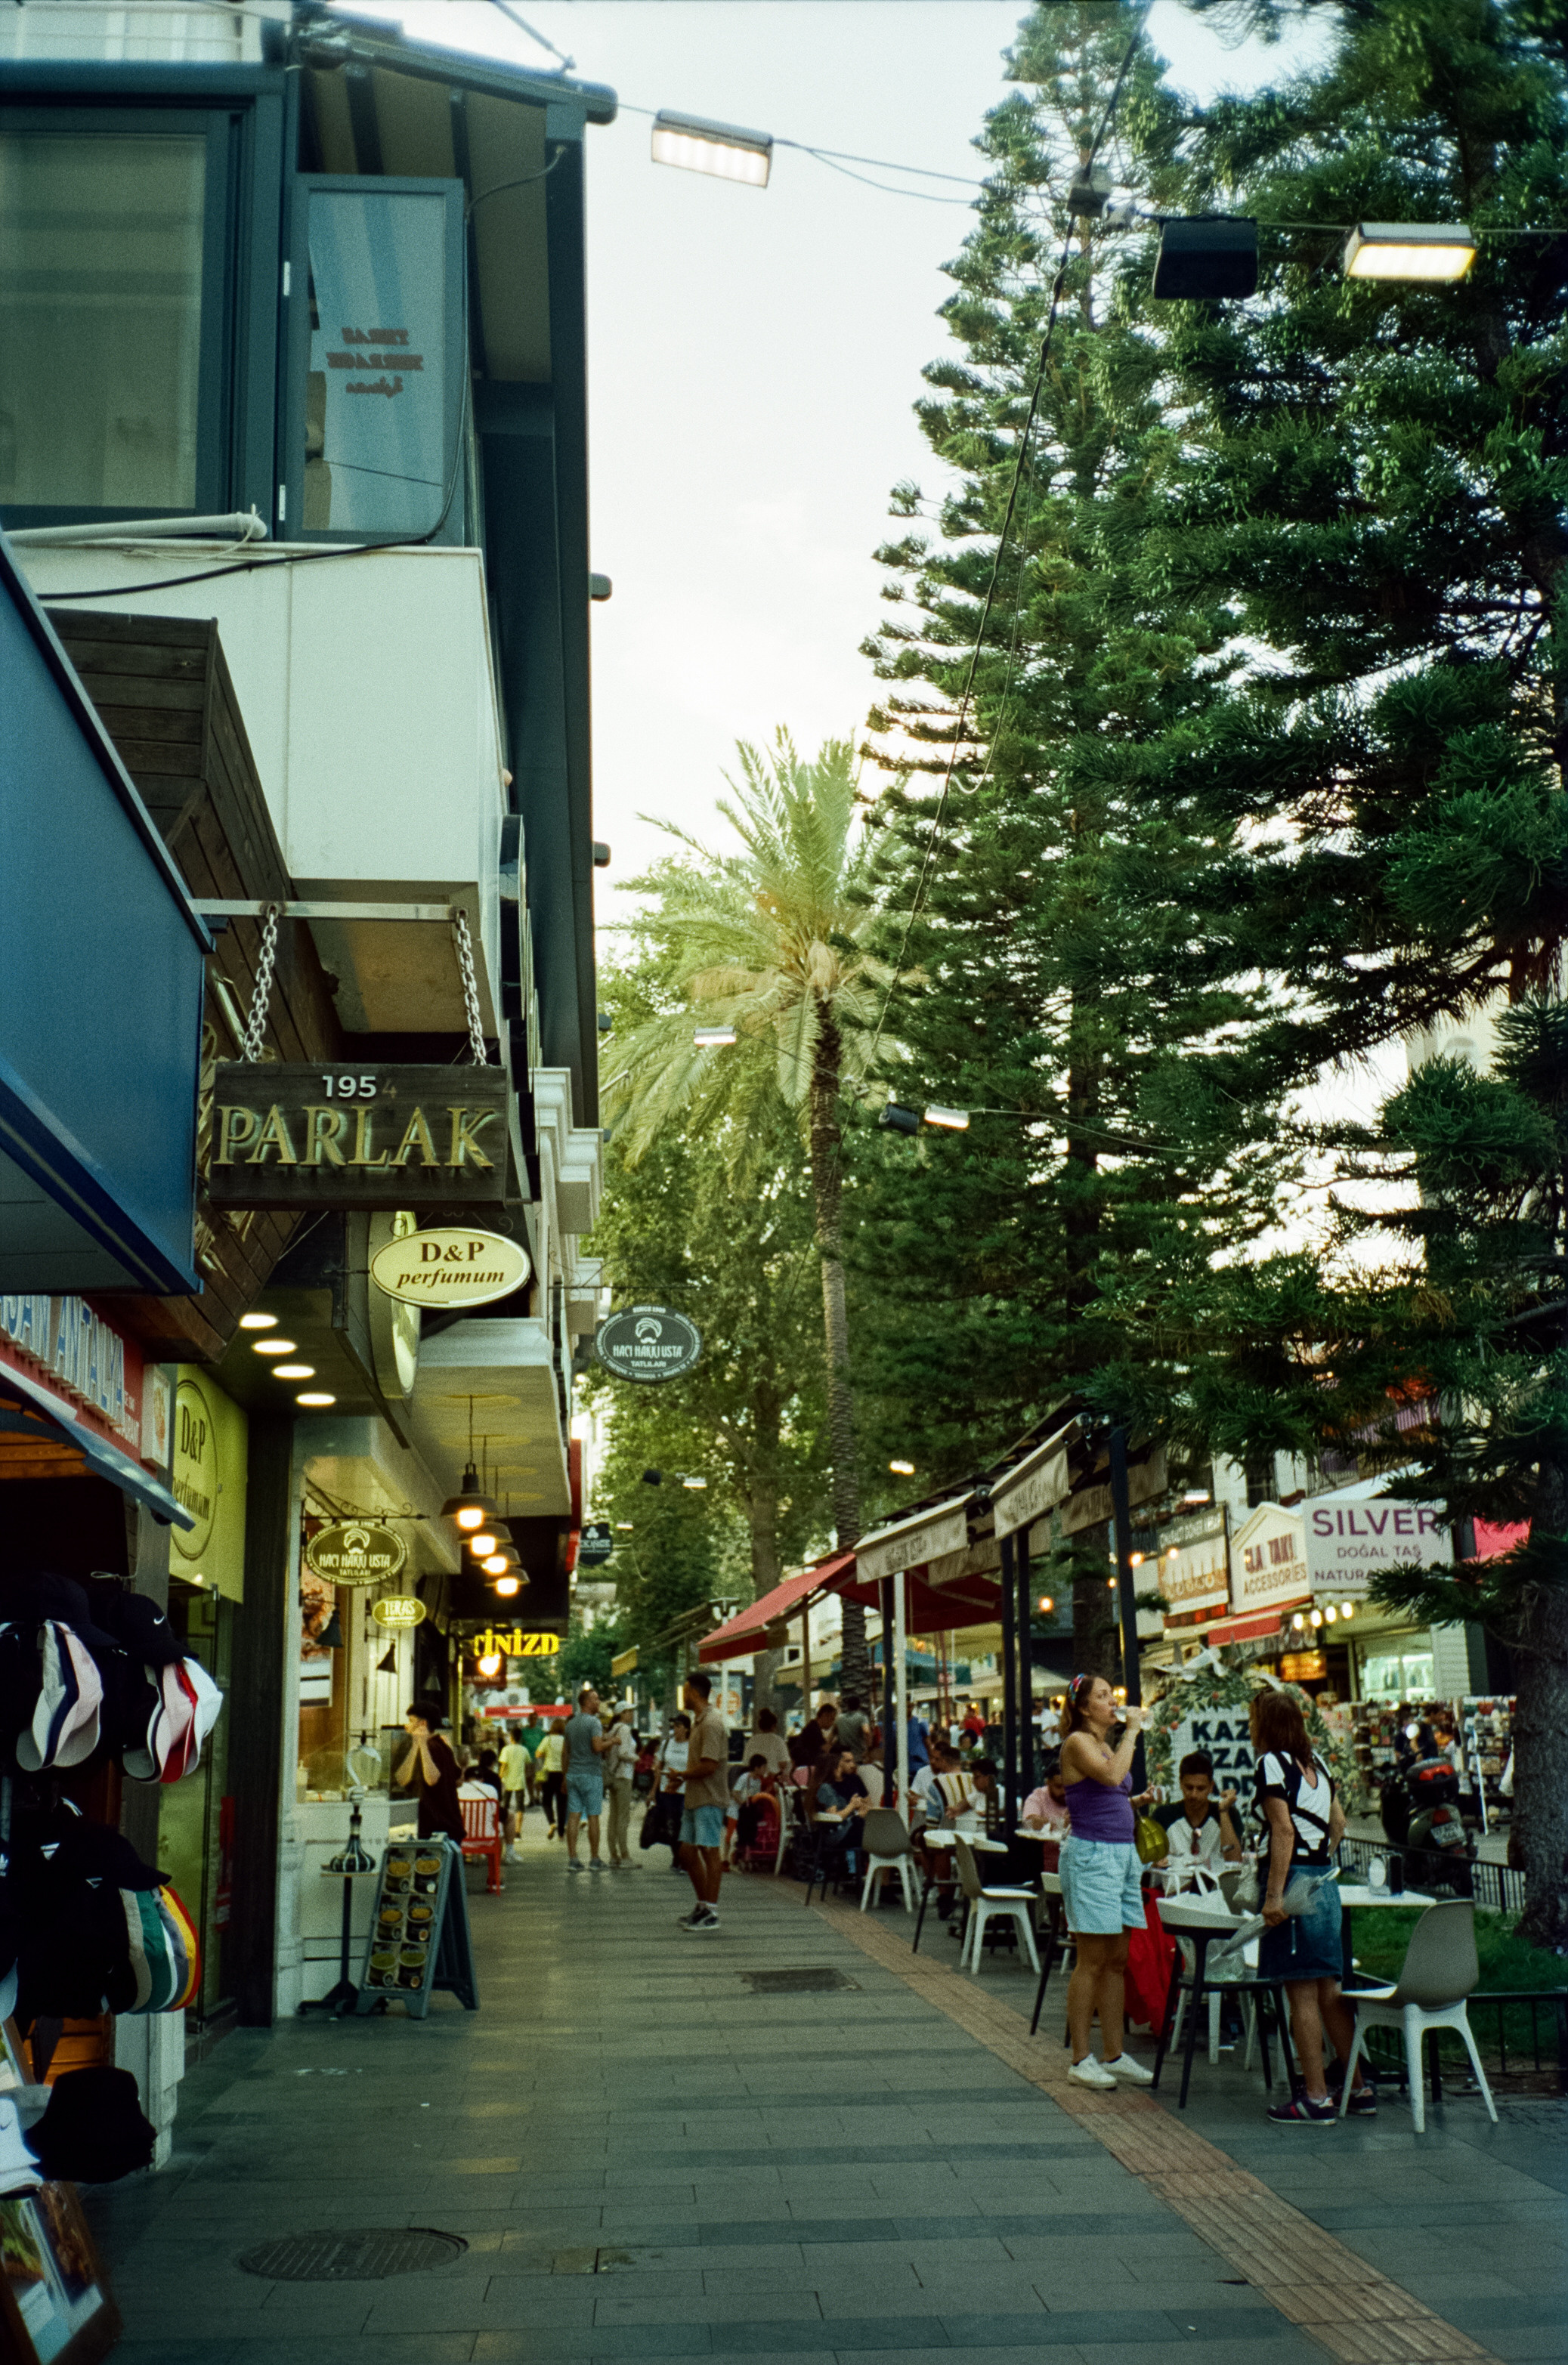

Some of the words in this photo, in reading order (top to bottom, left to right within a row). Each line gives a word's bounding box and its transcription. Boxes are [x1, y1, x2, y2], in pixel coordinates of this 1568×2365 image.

[212, 1103, 496, 1167] PARLAK
[419, 1241, 485, 1263] D&P
[397, 1268, 505, 1289] perfumum
[181, 1405, 206, 1464] D&P
[1313, 1508, 1437, 1537] SILVER
[1337, 1544, 1387, 1559] DOĞAL
[1395, 1545, 1422, 1560] TAŞ
[1244, 1562, 1307, 1596] ACCESSORIES
